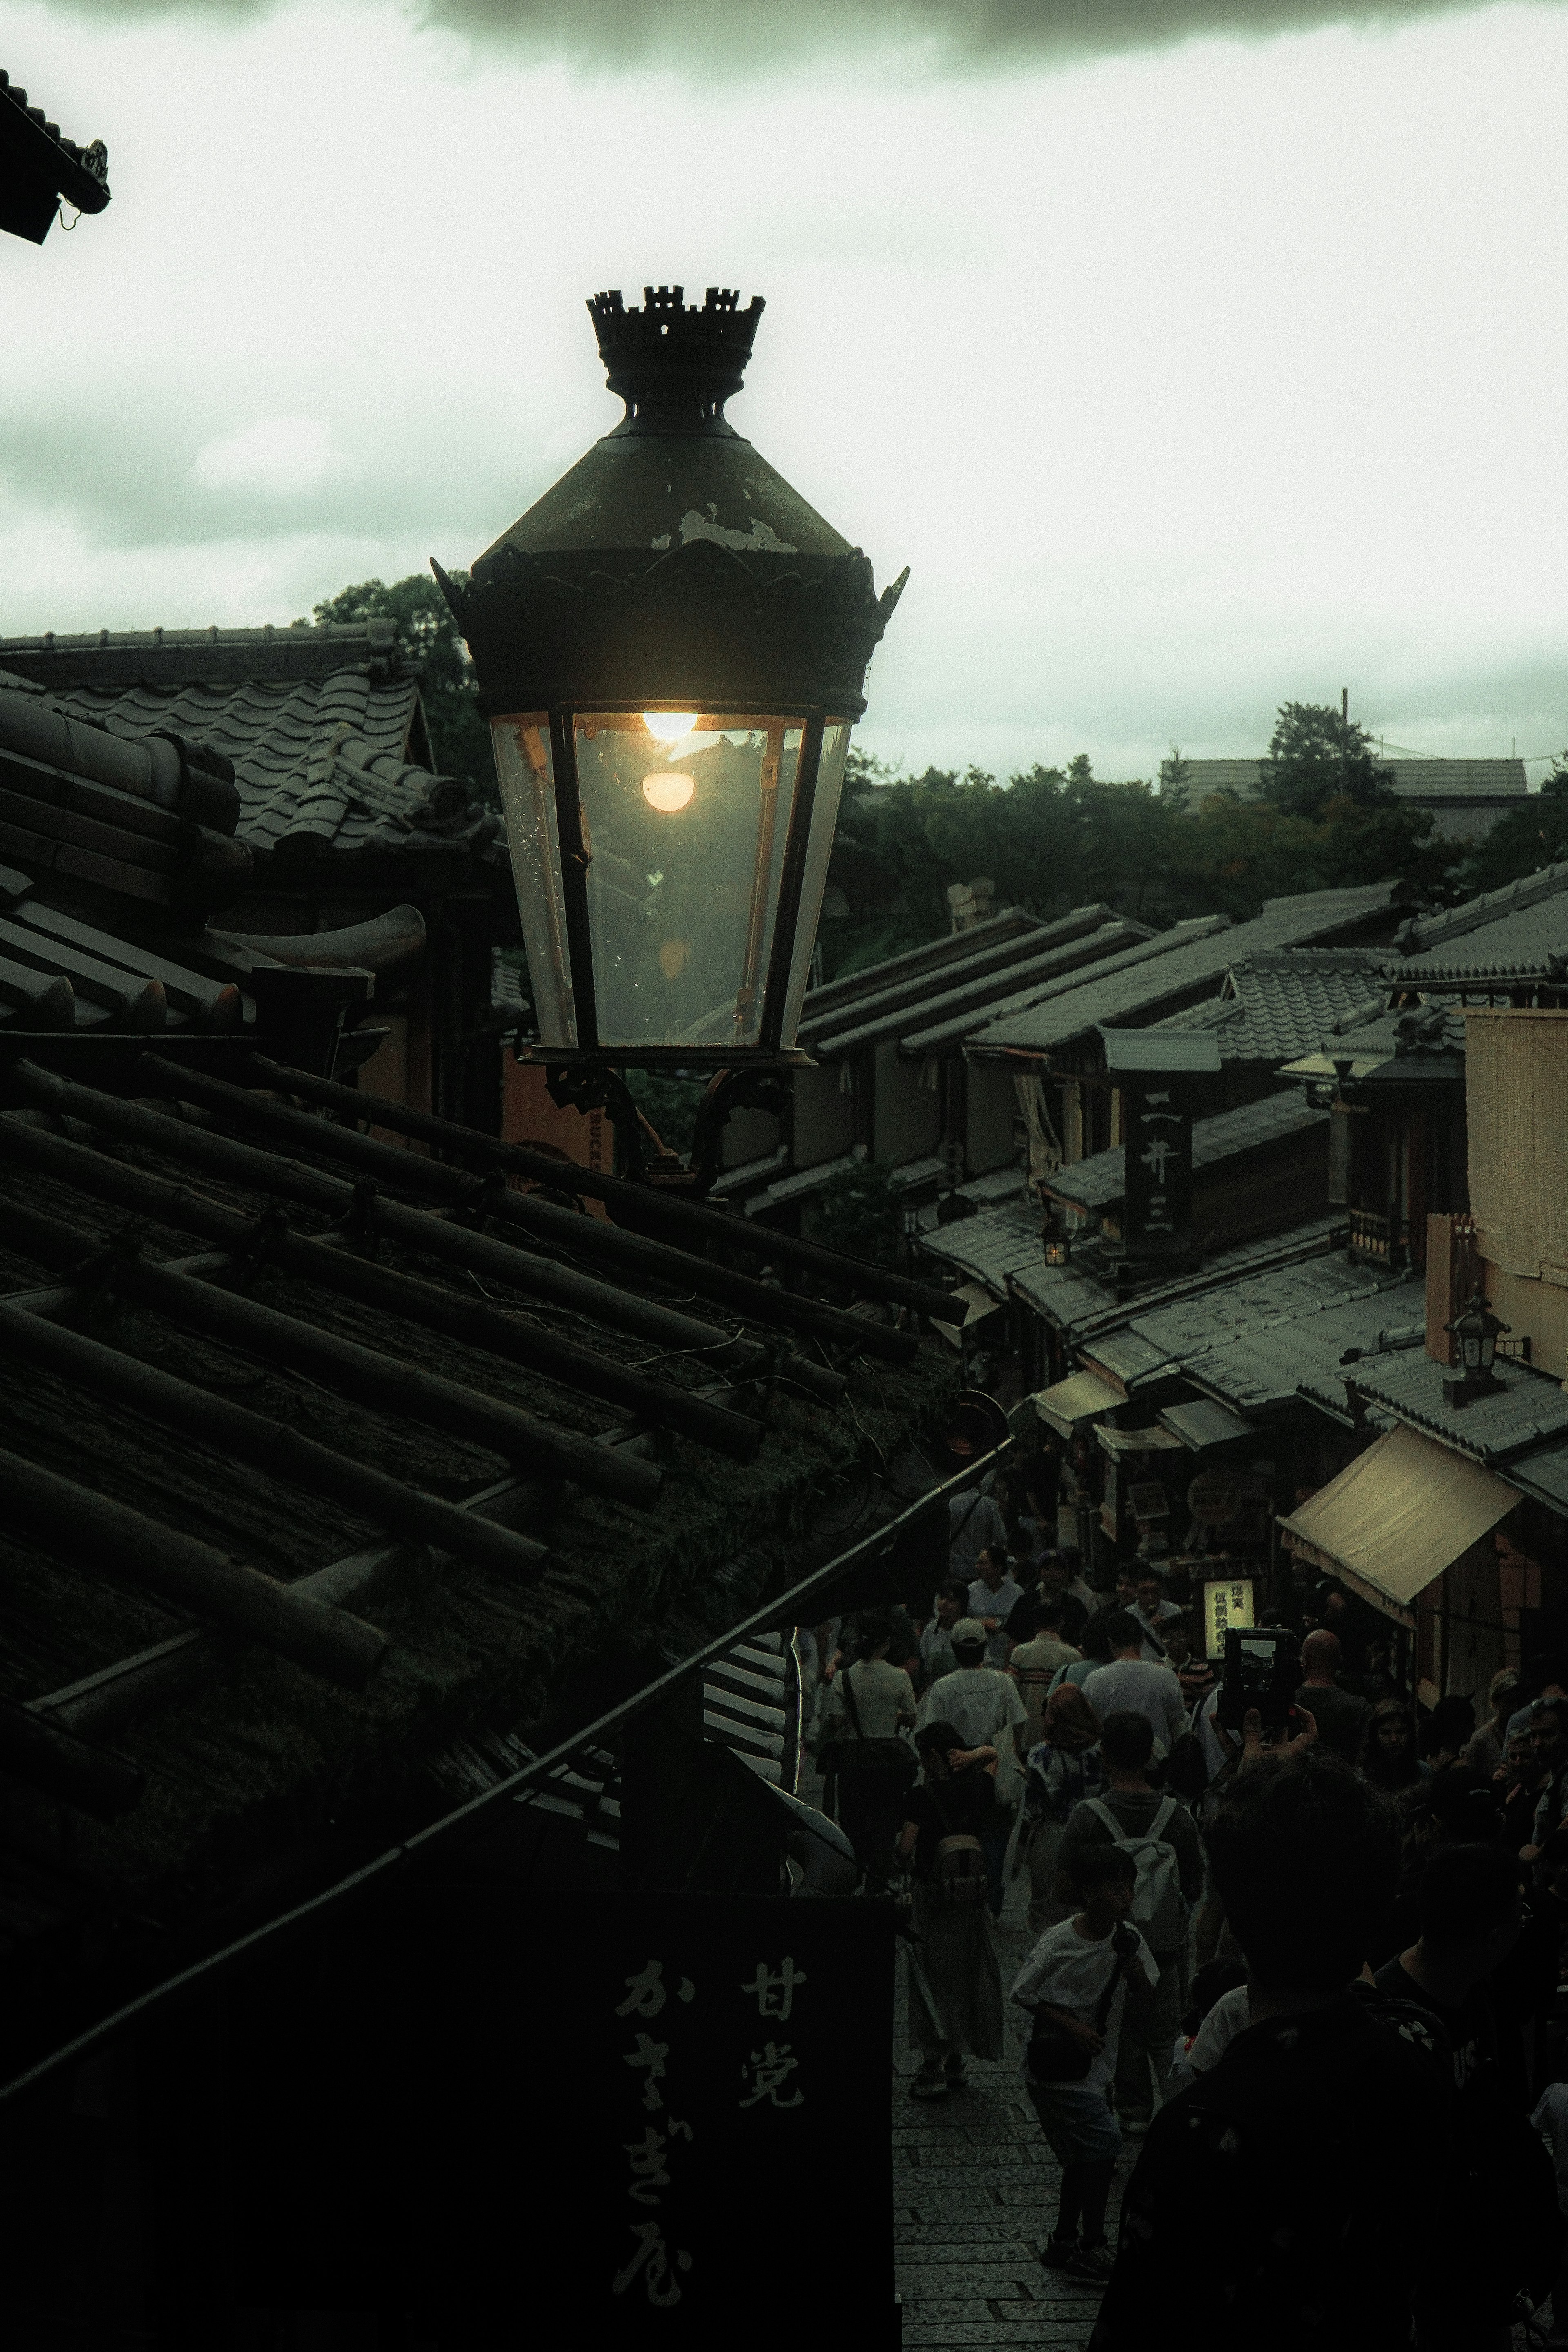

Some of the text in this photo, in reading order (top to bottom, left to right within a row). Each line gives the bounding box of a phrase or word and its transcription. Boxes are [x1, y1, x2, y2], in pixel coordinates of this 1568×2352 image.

[611, 1959, 696, 2308] かさぎ屋
[739, 1955, 807, 2110] 甘党
